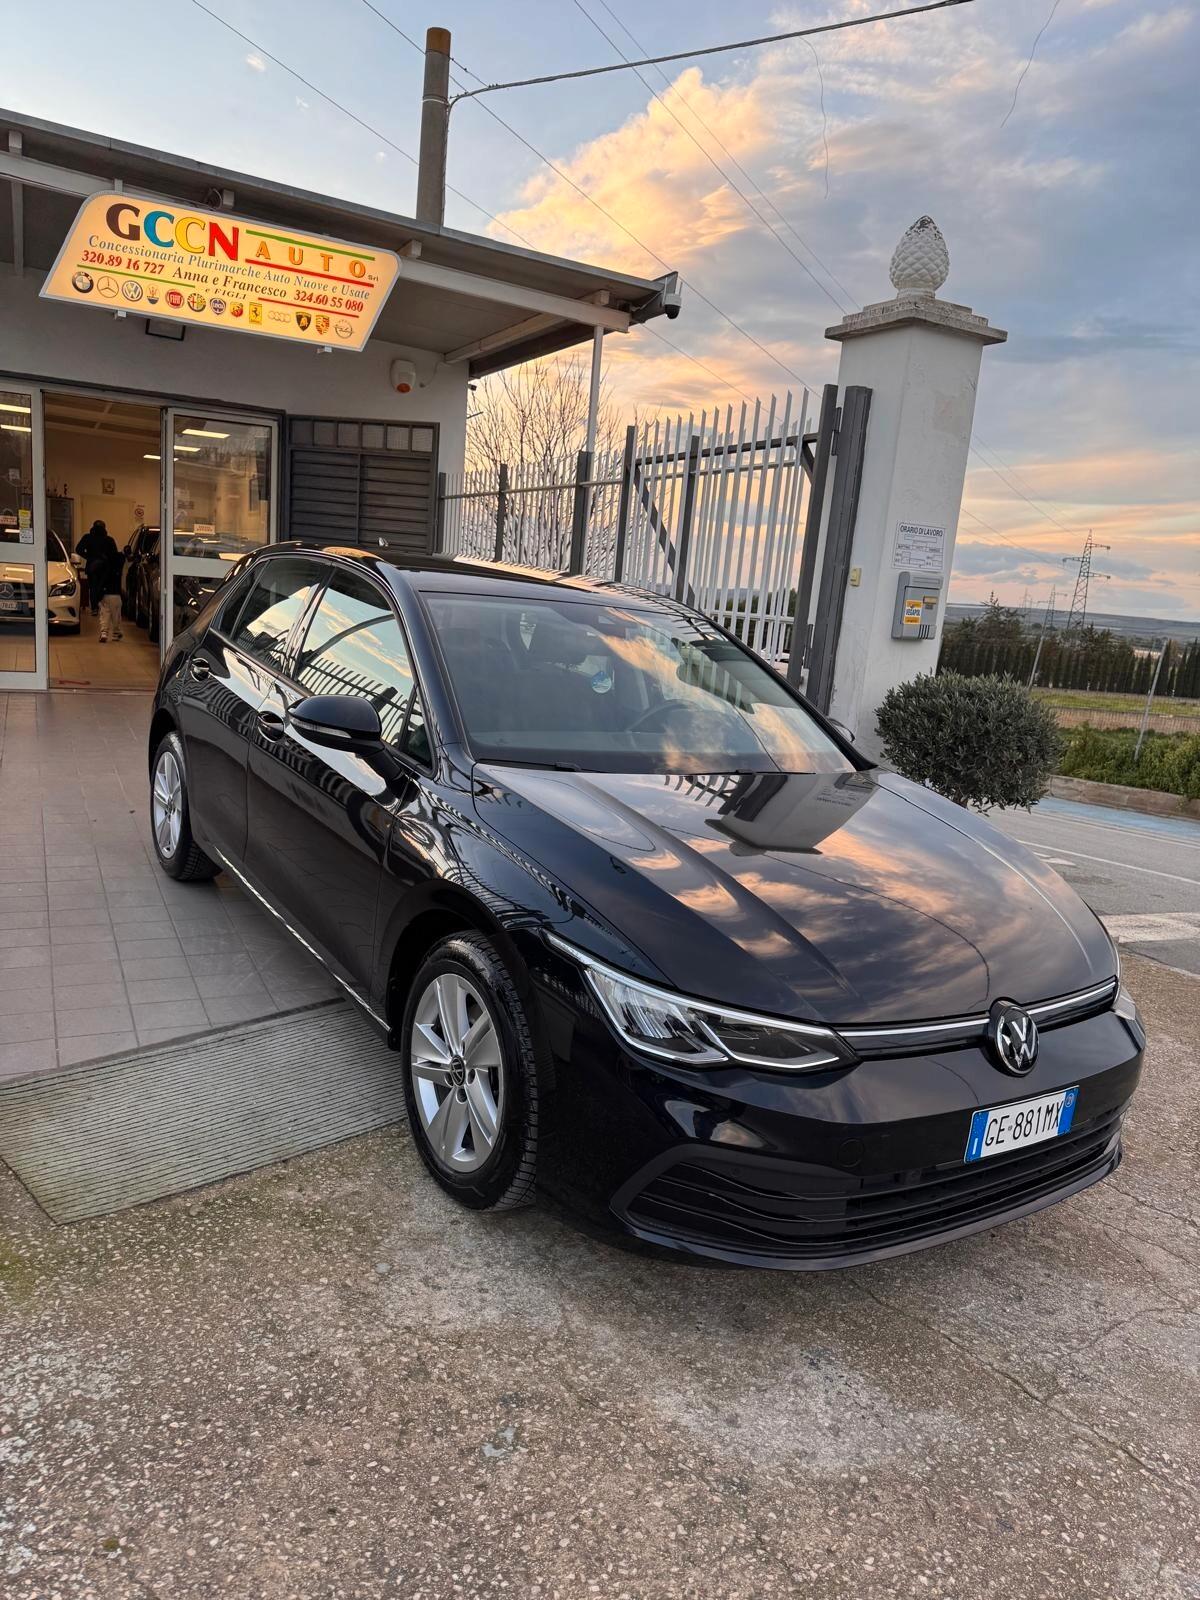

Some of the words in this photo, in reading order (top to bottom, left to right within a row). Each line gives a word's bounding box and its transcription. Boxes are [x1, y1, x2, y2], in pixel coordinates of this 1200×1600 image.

[105, 203, 240, 261] GCCN
[255, 240, 366, 279] AUTO
[82, 250, 122, 267] 320.89
[125, 258, 140, 271] 16
[143, 261, 165, 275] 727
[89, 235, 184, 264] Concessionaria
[188, 255, 261, 278] Plurimarche
[263, 270, 291, 285] Auto
[293, 276, 329, 293] Nuove
[331, 285, 338, 293] e
[341, 284, 370, 300] Usate
[172, 267, 209, 284] Anna
[212, 277, 219, 285] e
[223, 276, 287, 298] Francesco
[293, 289, 328, 306] 324.60
[329, 295, 343, 309] 55
[345, 299, 364, 313] 080
[900, 525, 918, 534] ORARIO
[923, 528, 943, 537] LAVORO
